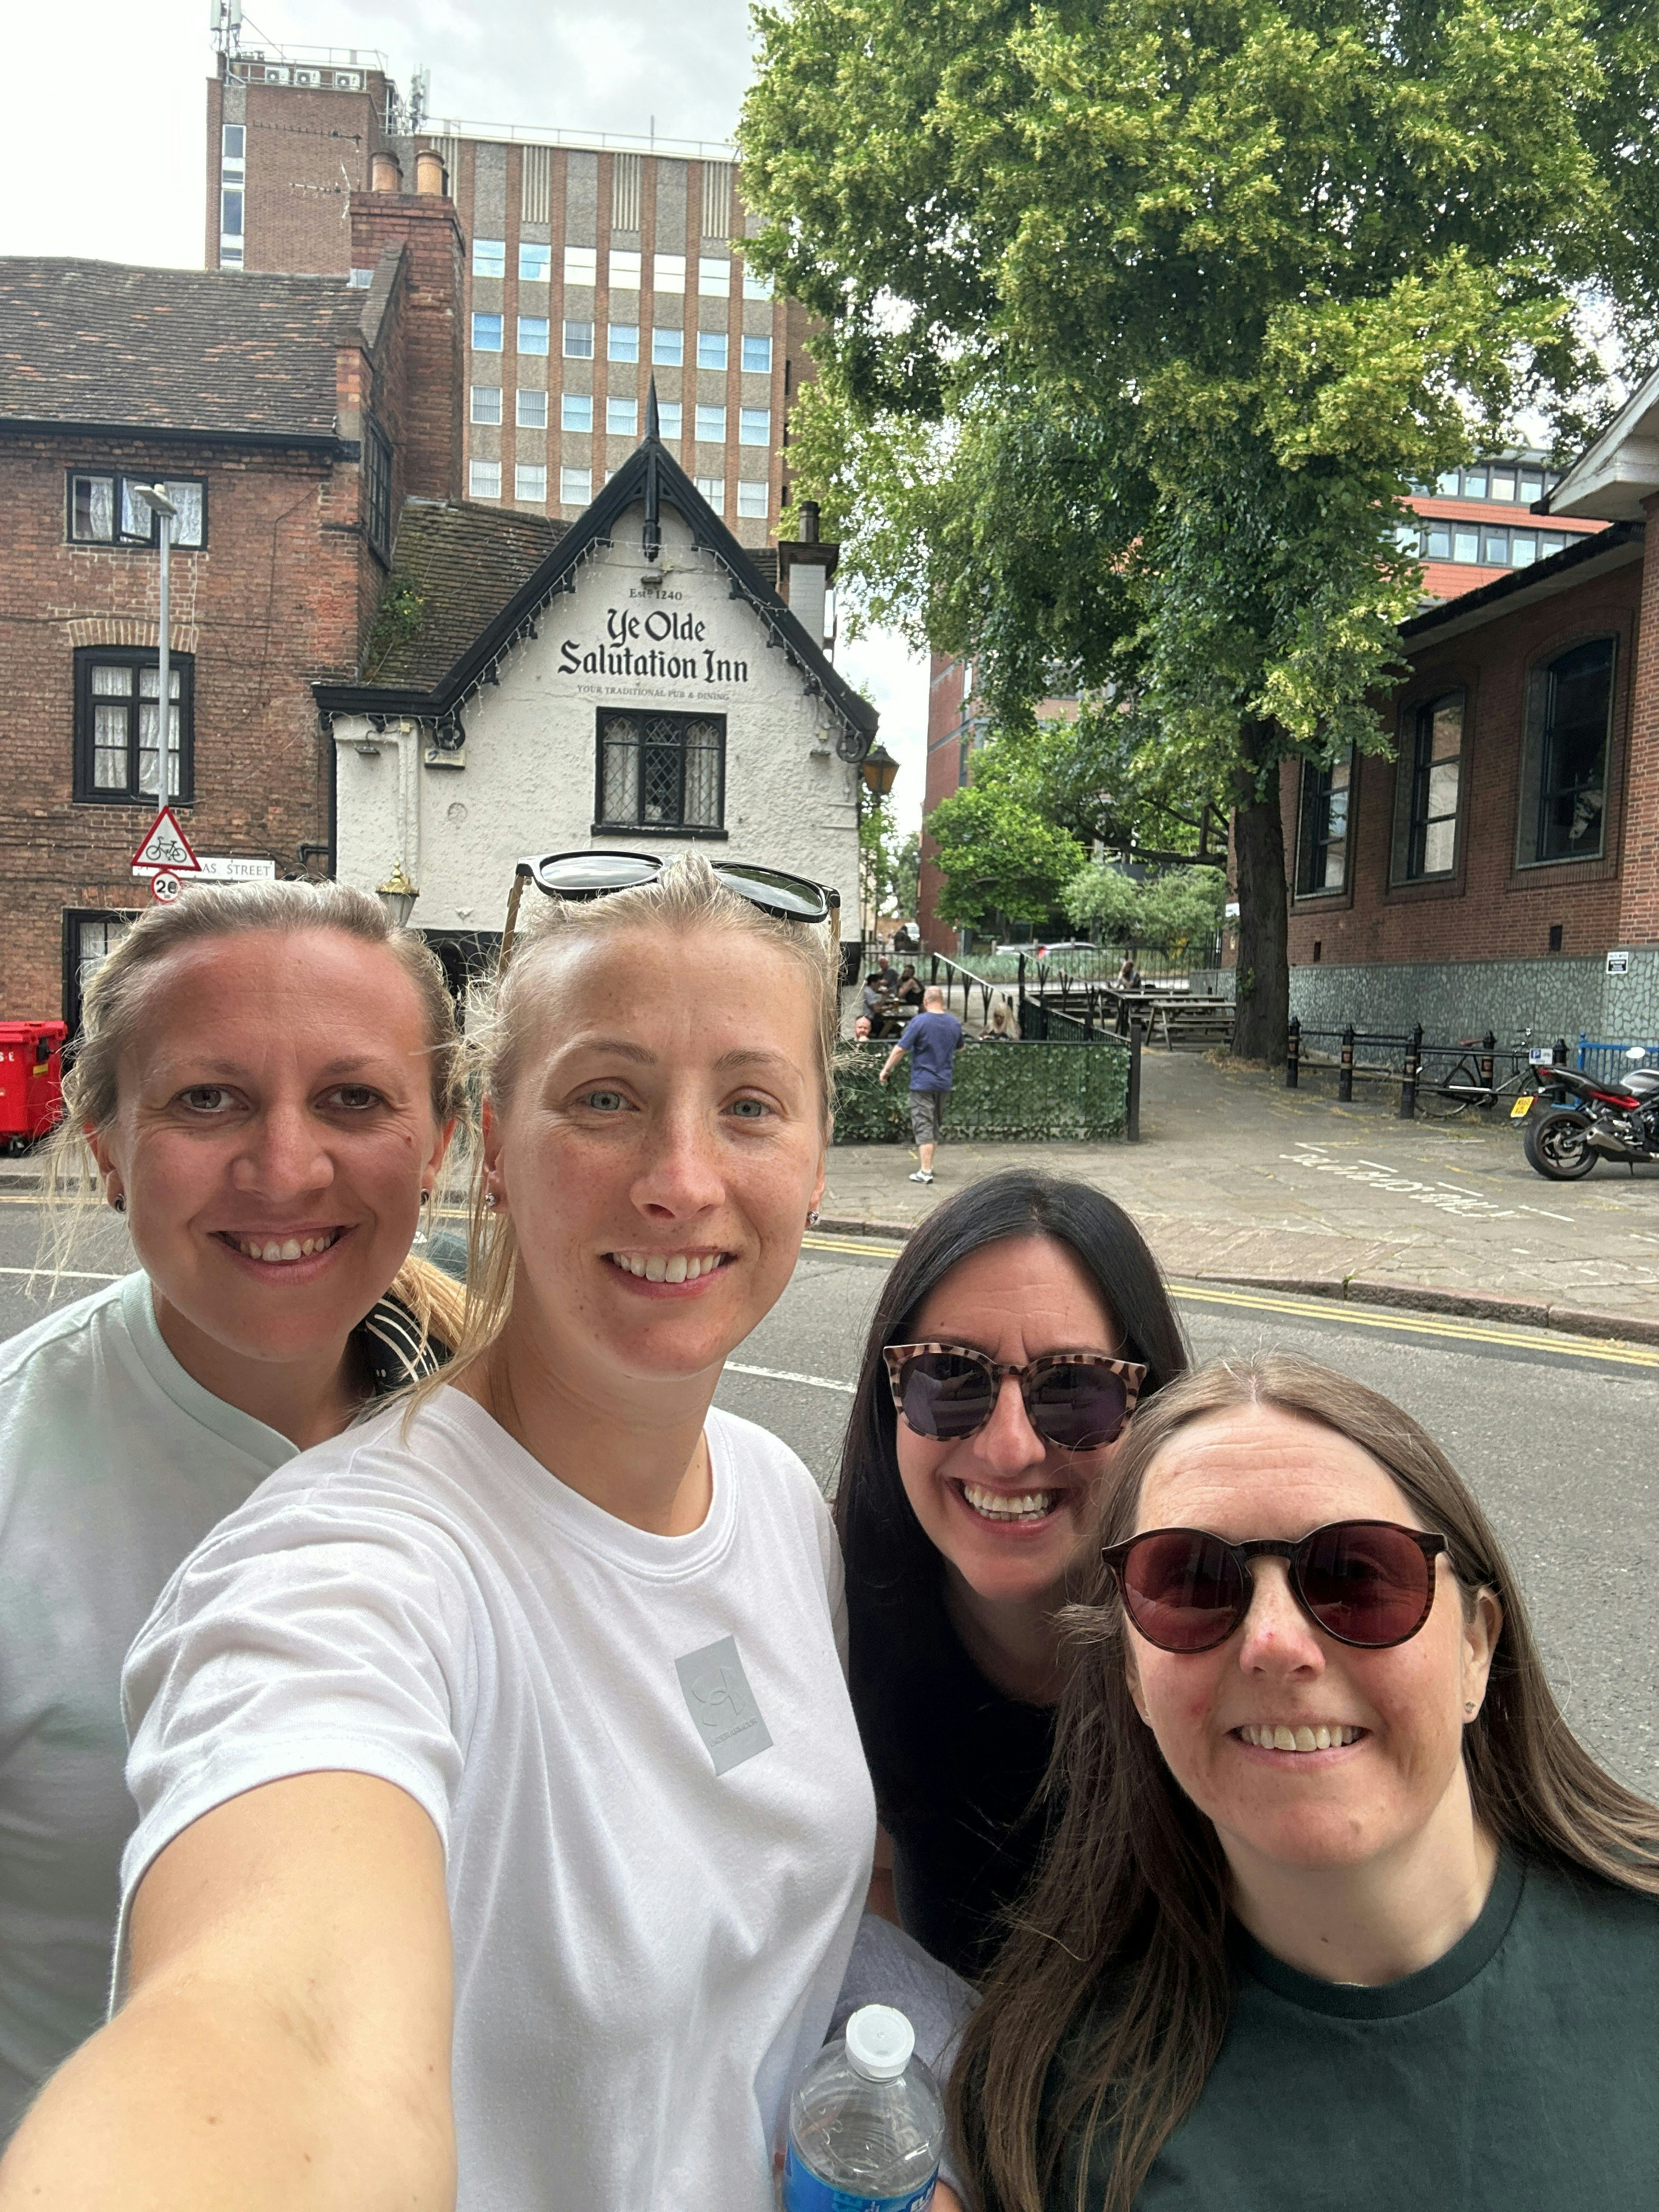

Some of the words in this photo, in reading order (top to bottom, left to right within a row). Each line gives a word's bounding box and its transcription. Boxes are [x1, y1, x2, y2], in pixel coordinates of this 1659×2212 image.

[656, 590, 682, 600] 1240
[607, 608, 640, 648] Ye
[644, 610, 706, 642] Olde
[557, 639, 697, 679] Salutation
[702, 648, 748, 684] Inn
[577, 685, 602, 694] YOUR
[605, 687, 666, 697] TRADITIONAL
[697, 692, 730, 701] DINING
[227, 864, 271, 876] STREET
[156, 879, 178, 894] 20
